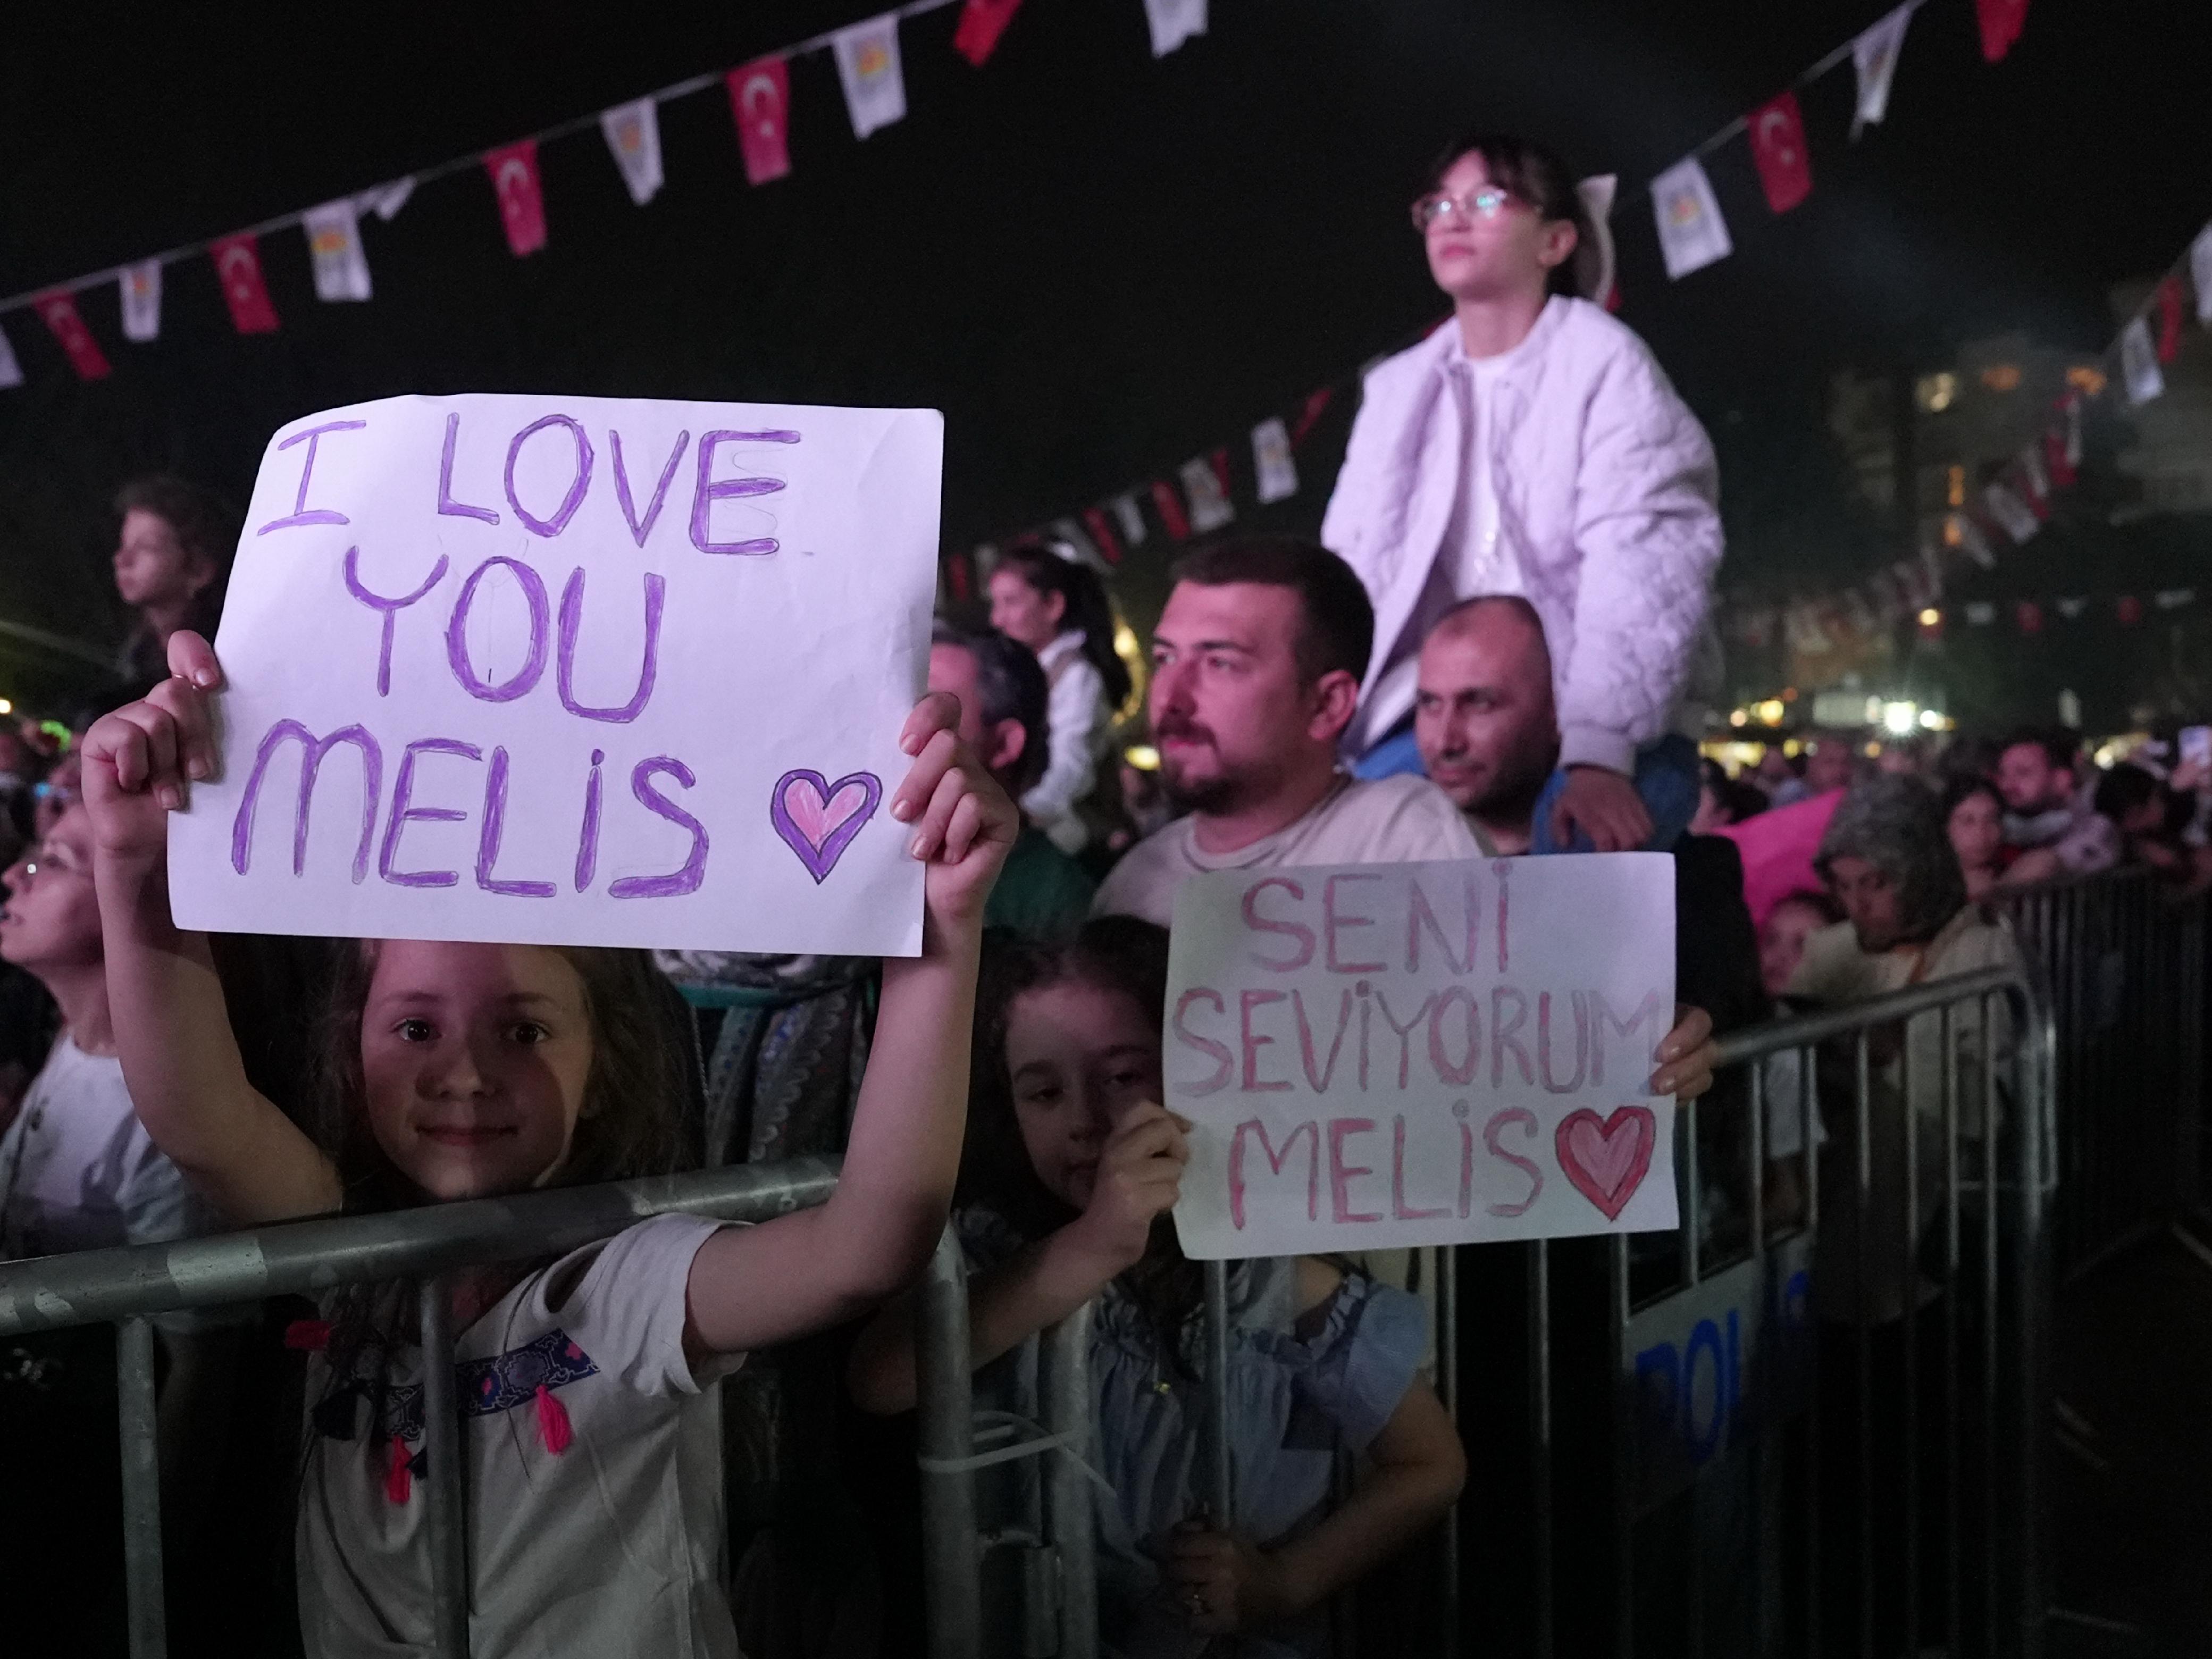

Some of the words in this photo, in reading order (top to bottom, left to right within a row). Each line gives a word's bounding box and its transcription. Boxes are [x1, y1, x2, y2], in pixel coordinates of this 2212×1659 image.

[257, 420, 366, 537] I
[438, 412, 801, 555] LOVE
[343, 544, 666, 724] YOU
